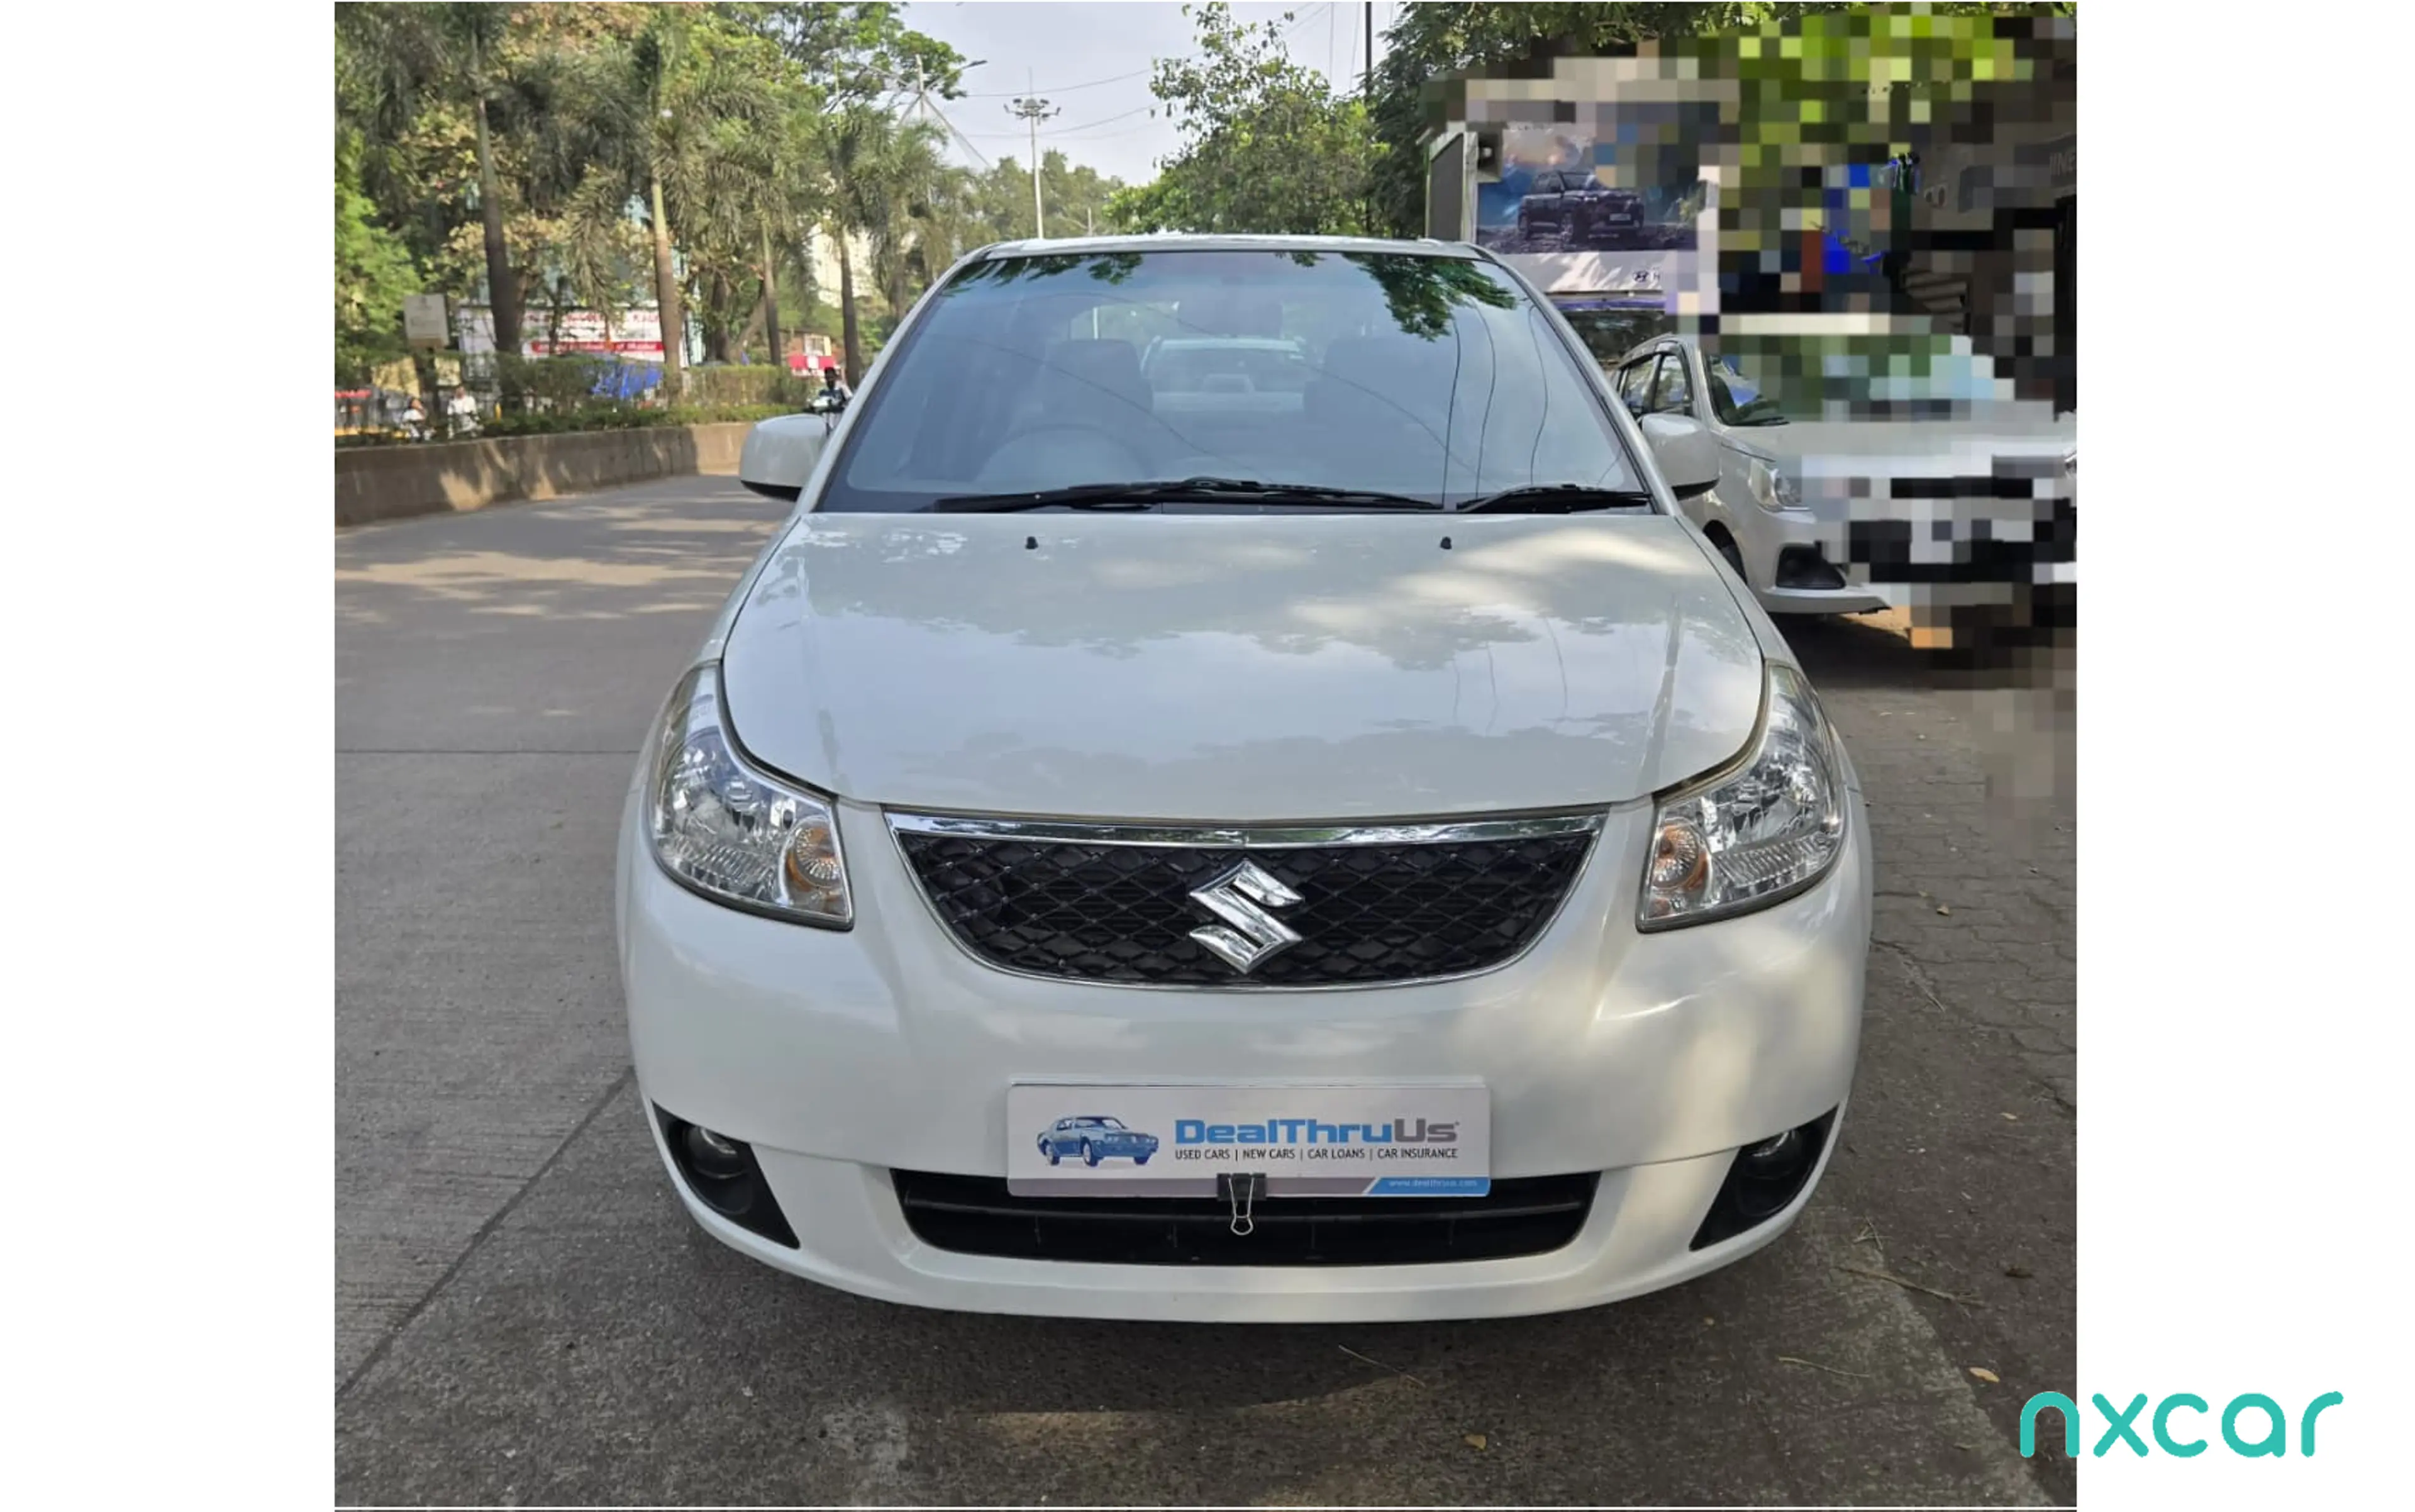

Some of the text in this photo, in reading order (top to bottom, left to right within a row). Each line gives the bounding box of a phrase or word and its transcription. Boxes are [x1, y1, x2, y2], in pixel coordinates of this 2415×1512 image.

[1175, 1119, 1457, 1143] DealThruUs
[1175, 1148, 1458, 1160] USED CARS NEW CARS CAR LOANS CAR INSURANCE
